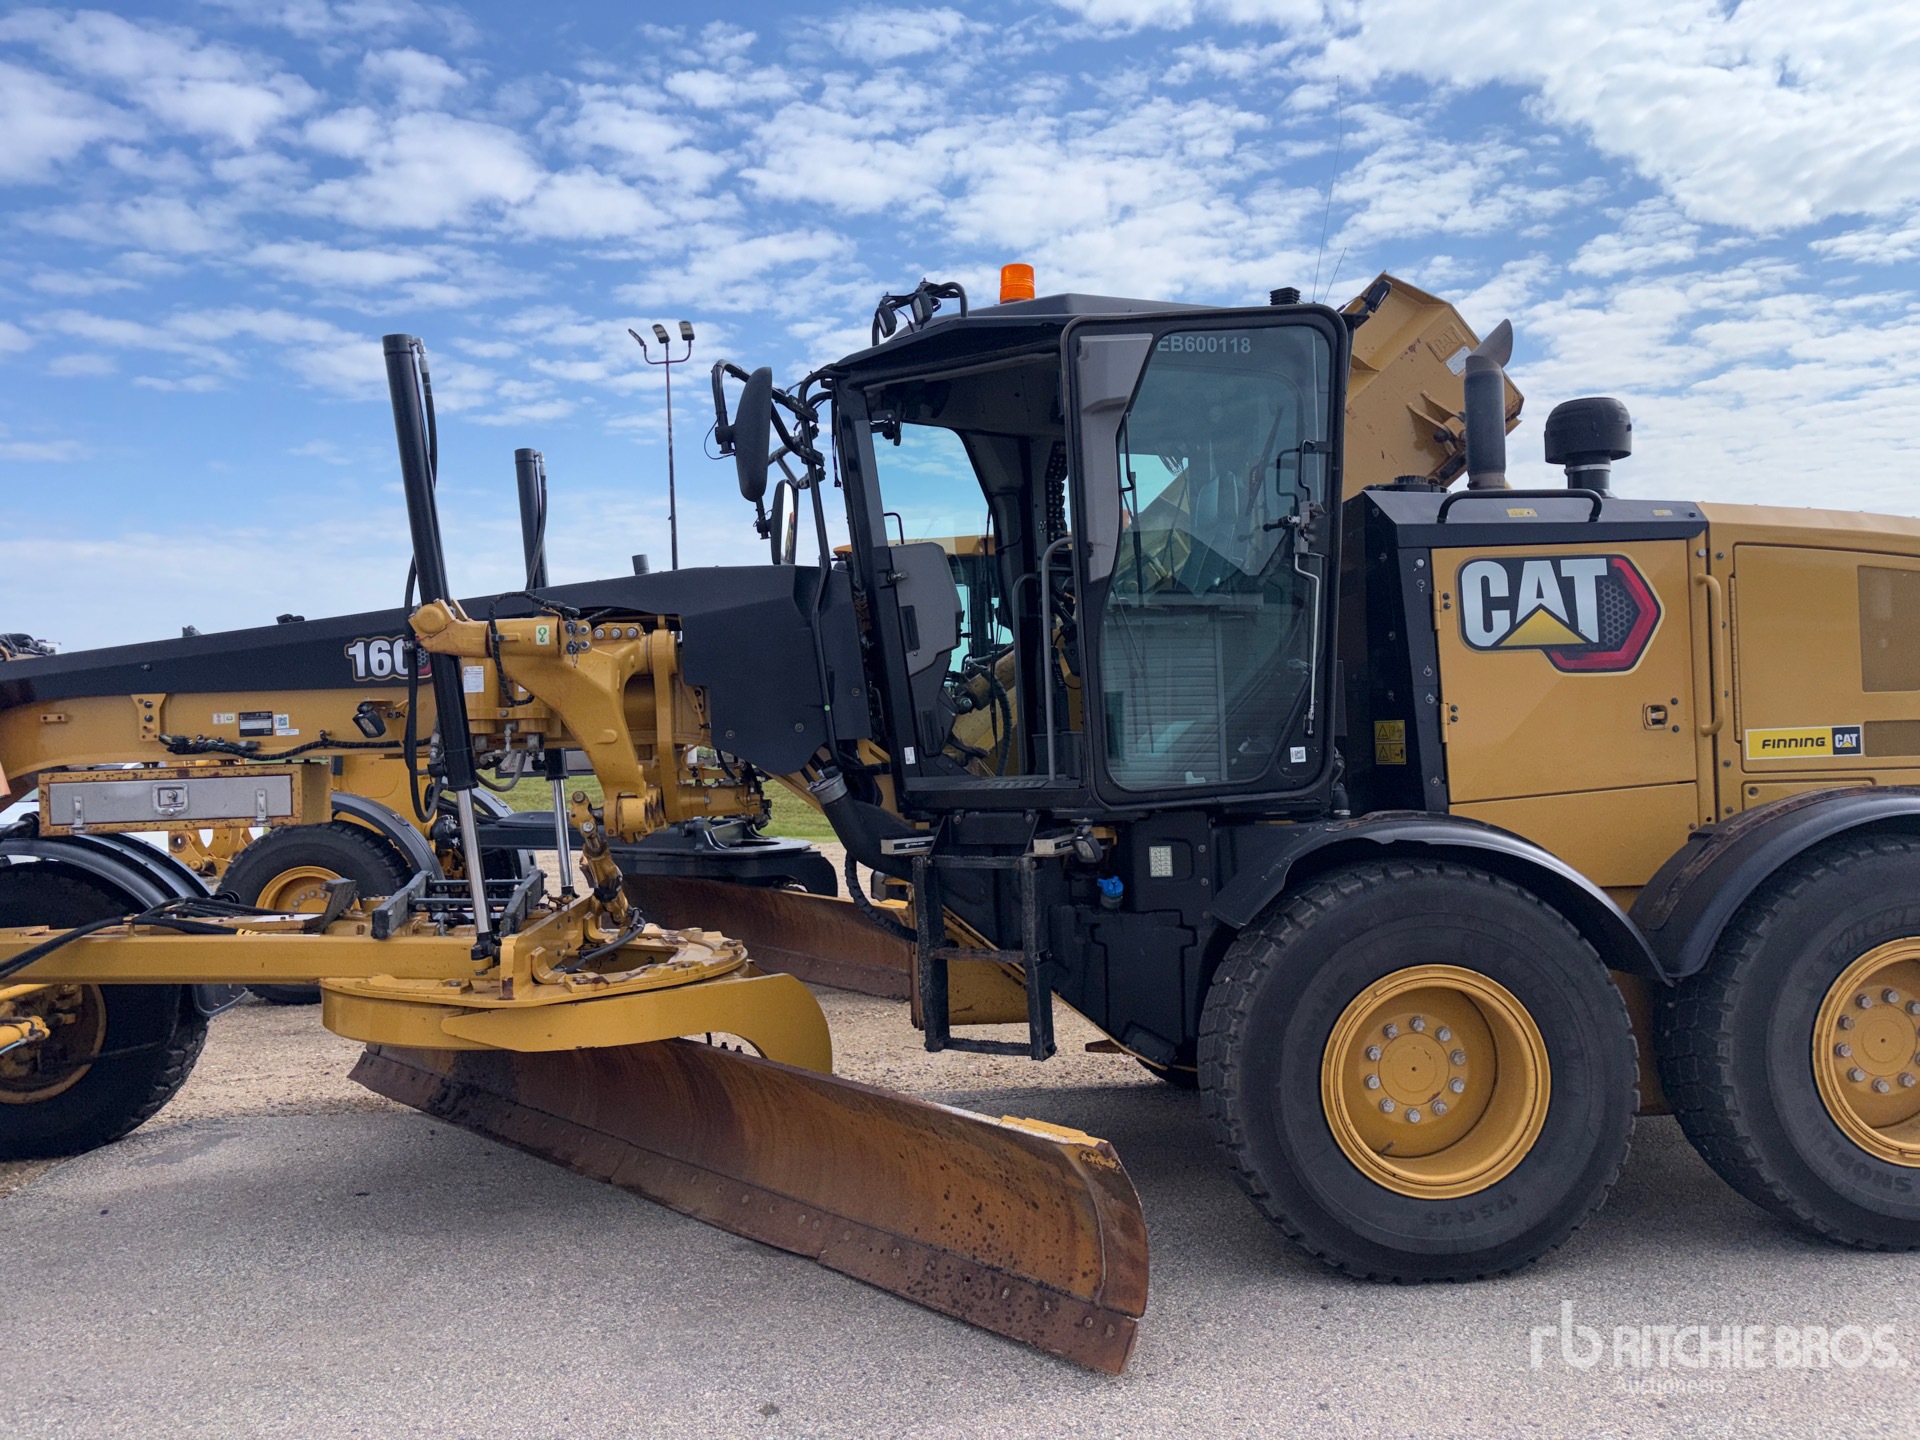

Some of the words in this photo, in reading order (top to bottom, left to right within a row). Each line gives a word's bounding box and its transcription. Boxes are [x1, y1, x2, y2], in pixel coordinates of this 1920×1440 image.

[1157, 335, 1251, 354] EB600118
[1461, 558, 1608, 647] CAT
[1761, 737, 1826, 749] FINNING
[1834, 733, 1858, 748] CAT
